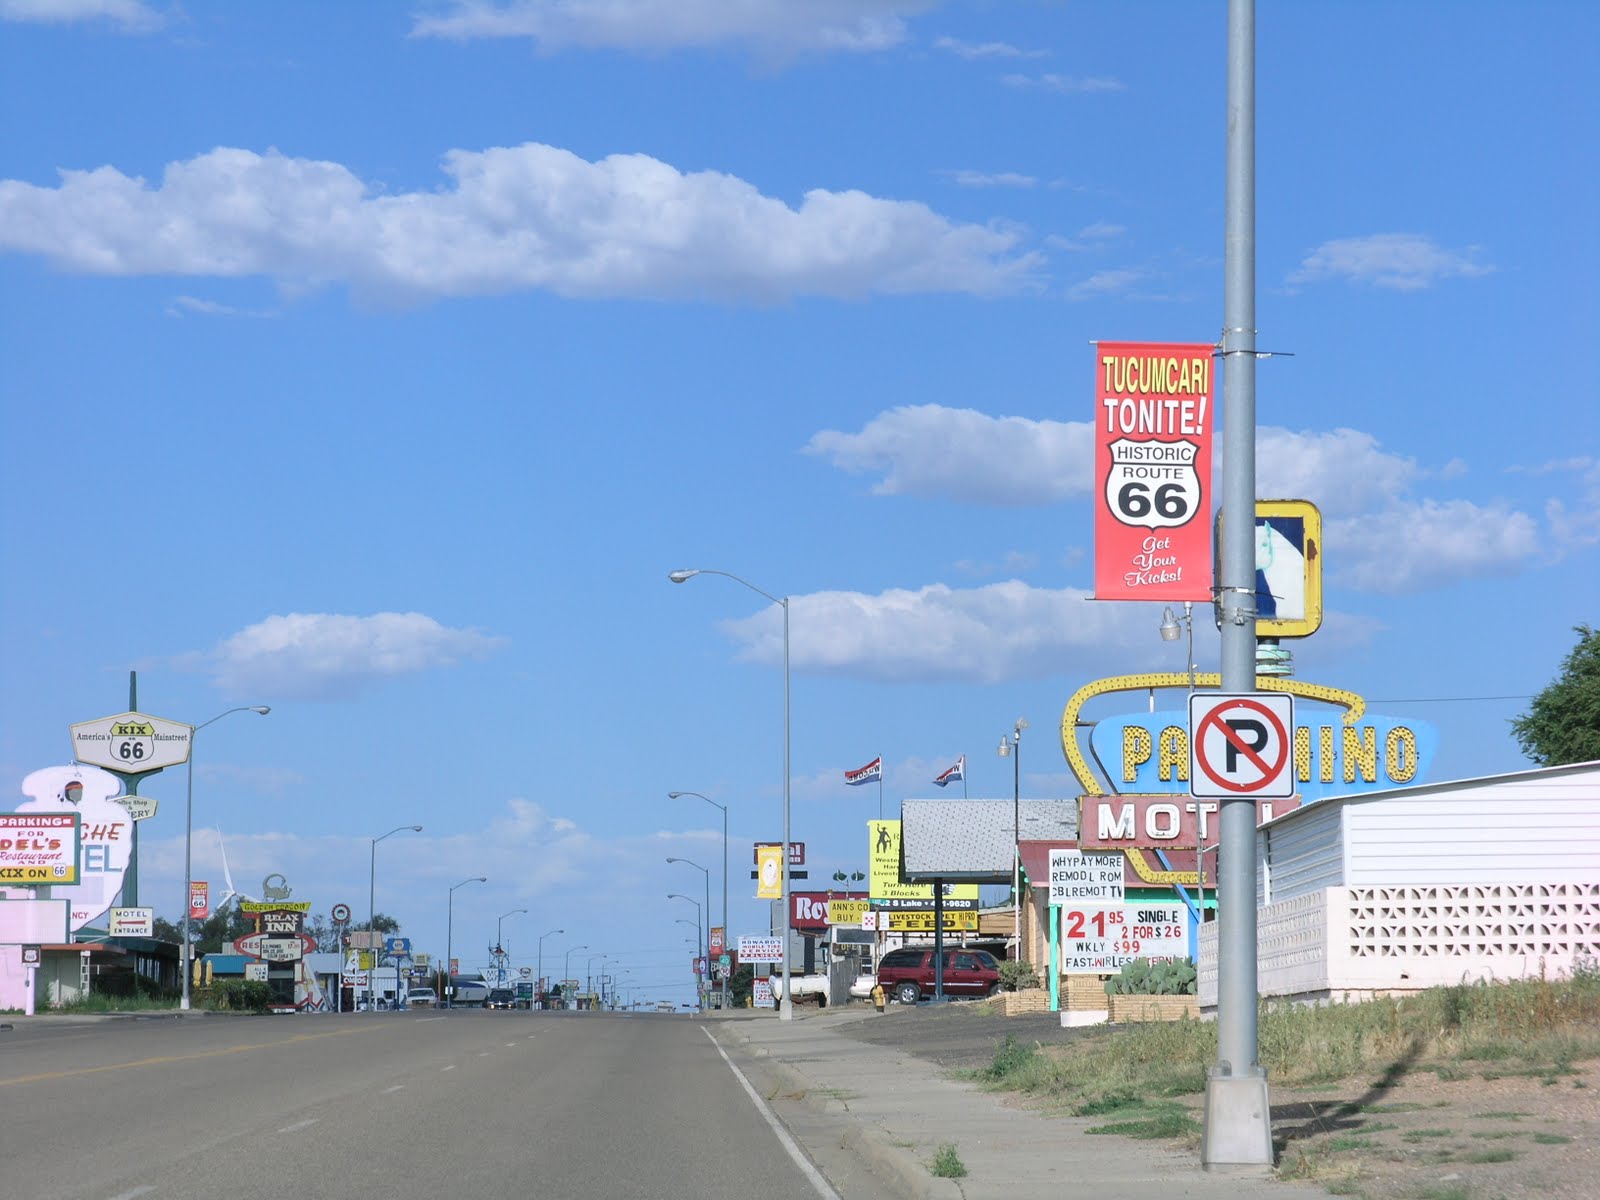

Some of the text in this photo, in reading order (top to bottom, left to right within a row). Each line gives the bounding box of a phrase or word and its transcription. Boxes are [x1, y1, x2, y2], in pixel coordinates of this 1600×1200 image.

[1102, 356, 1209, 394] TUCUMCARI
[1103, 396, 1207, 435] TONITE!
[1117, 446, 1192, 461] HISTORIC
[1122, 467, 1184, 479] ROUTE
[1117, 482, 1188, 519] 66
[1142, 536, 1171, 554] Get
[1133, 554, 1176, 572] Your
[1123, 567, 1183, 587] Kicks!
[117, 726, 147, 735] KIX
[77, 733, 111, 741] America's
[154, 733, 188, 741] Mainstreet
[119, 742, 144, 759] 66
[1122, 725, 1418, 783] PAINO
[130, 810, 150, 819] ERY
[81, 823, 125, 841] CHE
[0, 837, 61, 850] DEL'S
[81, 845, 123, 872] EL
[28, 869, 47, 878] ON
[54, 866, 65, 875] 66
[1100, 872, 1122, 882] ROM
[244, 903, 274, 911] GOLDEN
[832, 903, 855, 911] ANN'S
[70, 912, 89, 920] NCY
[264, 914, 299, 922] RELAX
[837, 914, 854, 922] BUY
[1137, 910, 1178, 923] SINGLE
[266, 922, 297, 932] INN
[1121, 926, 1128, 939] 2
[1132, 926, 1153, 939] FOR
[1076, 942, 1105, 952] WKLY
